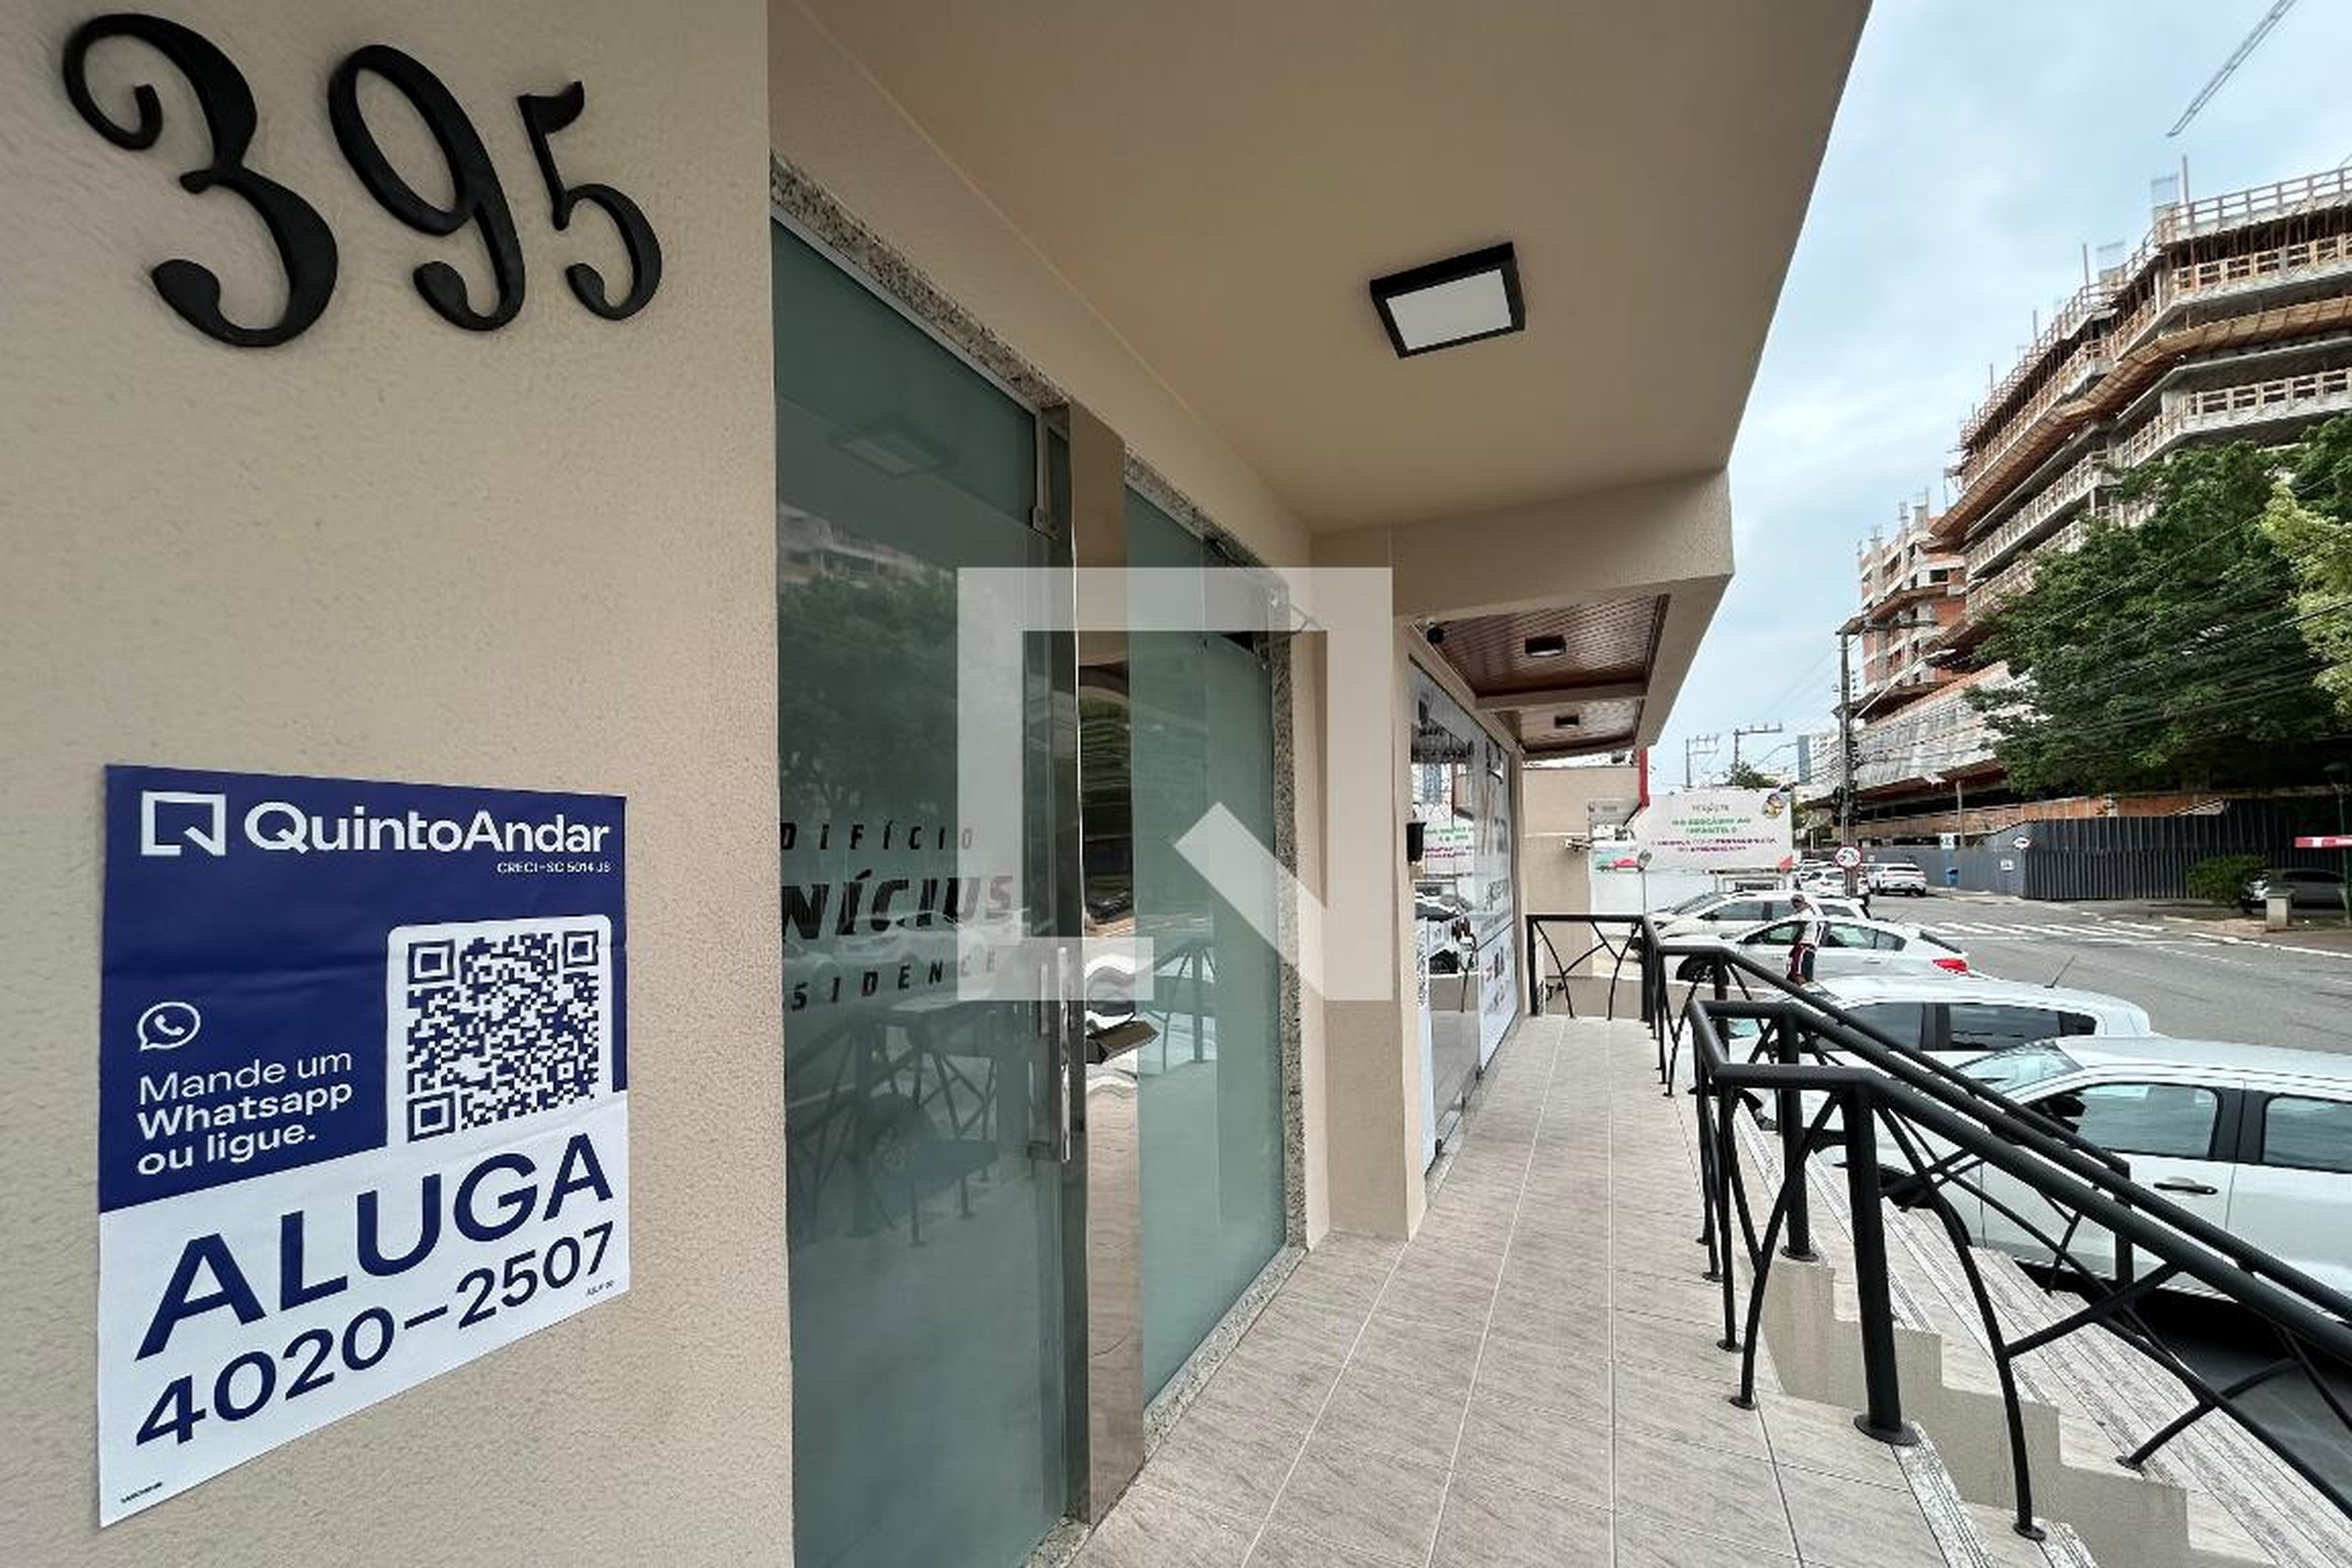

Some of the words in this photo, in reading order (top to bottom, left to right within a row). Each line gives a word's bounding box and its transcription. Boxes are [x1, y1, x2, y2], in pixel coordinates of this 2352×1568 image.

[61, 13, 662, 348] 395
[244, 800, 610, 854] QuintoAndar
[780, 820, 973, 850] DIFÍCIO
[781, 869, 1014, 940] NÍCIUS
[783, 947, 997, 1012] SIDENCE
[139, 1059, 287, 1106] Mande
[297, 1052, 352, 1080] um
[137, 1083, 353, 1140] Whatsapp
[137, 1145, 194, 1175] ou
[206, 1122, 316, 1163] ligue.
[135, 1133, 613, 1361] ALUGA
[135, 1221, 613, 1446] 4020-2507
